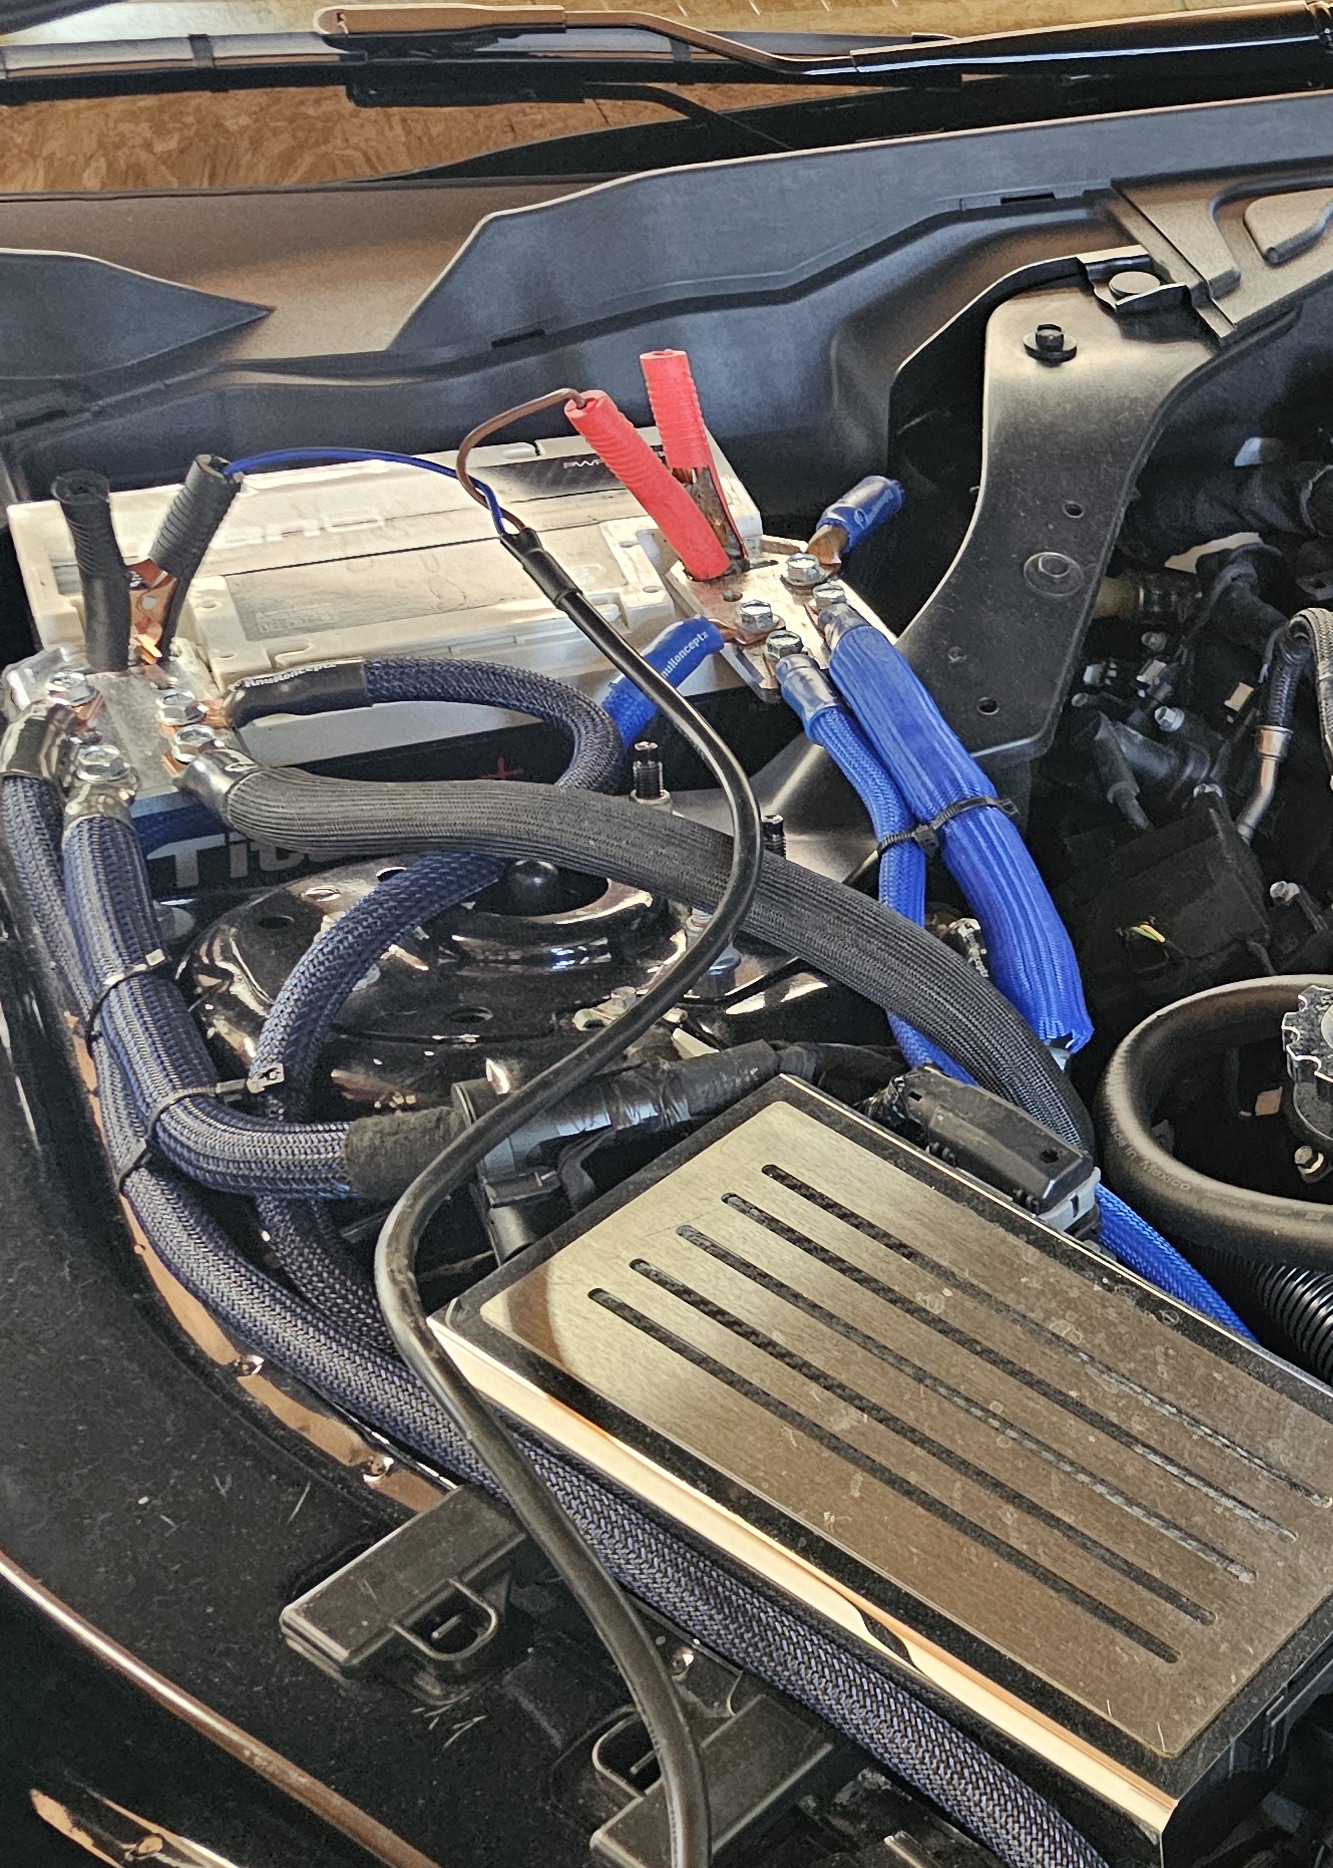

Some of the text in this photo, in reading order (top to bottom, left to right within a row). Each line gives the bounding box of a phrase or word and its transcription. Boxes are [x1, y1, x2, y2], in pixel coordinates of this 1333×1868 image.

[660, 631, 709, 679] nuKonceptz
[146, 832, 342, 888] Tit
[1138, 1159, 1192, 1192] Mexico
